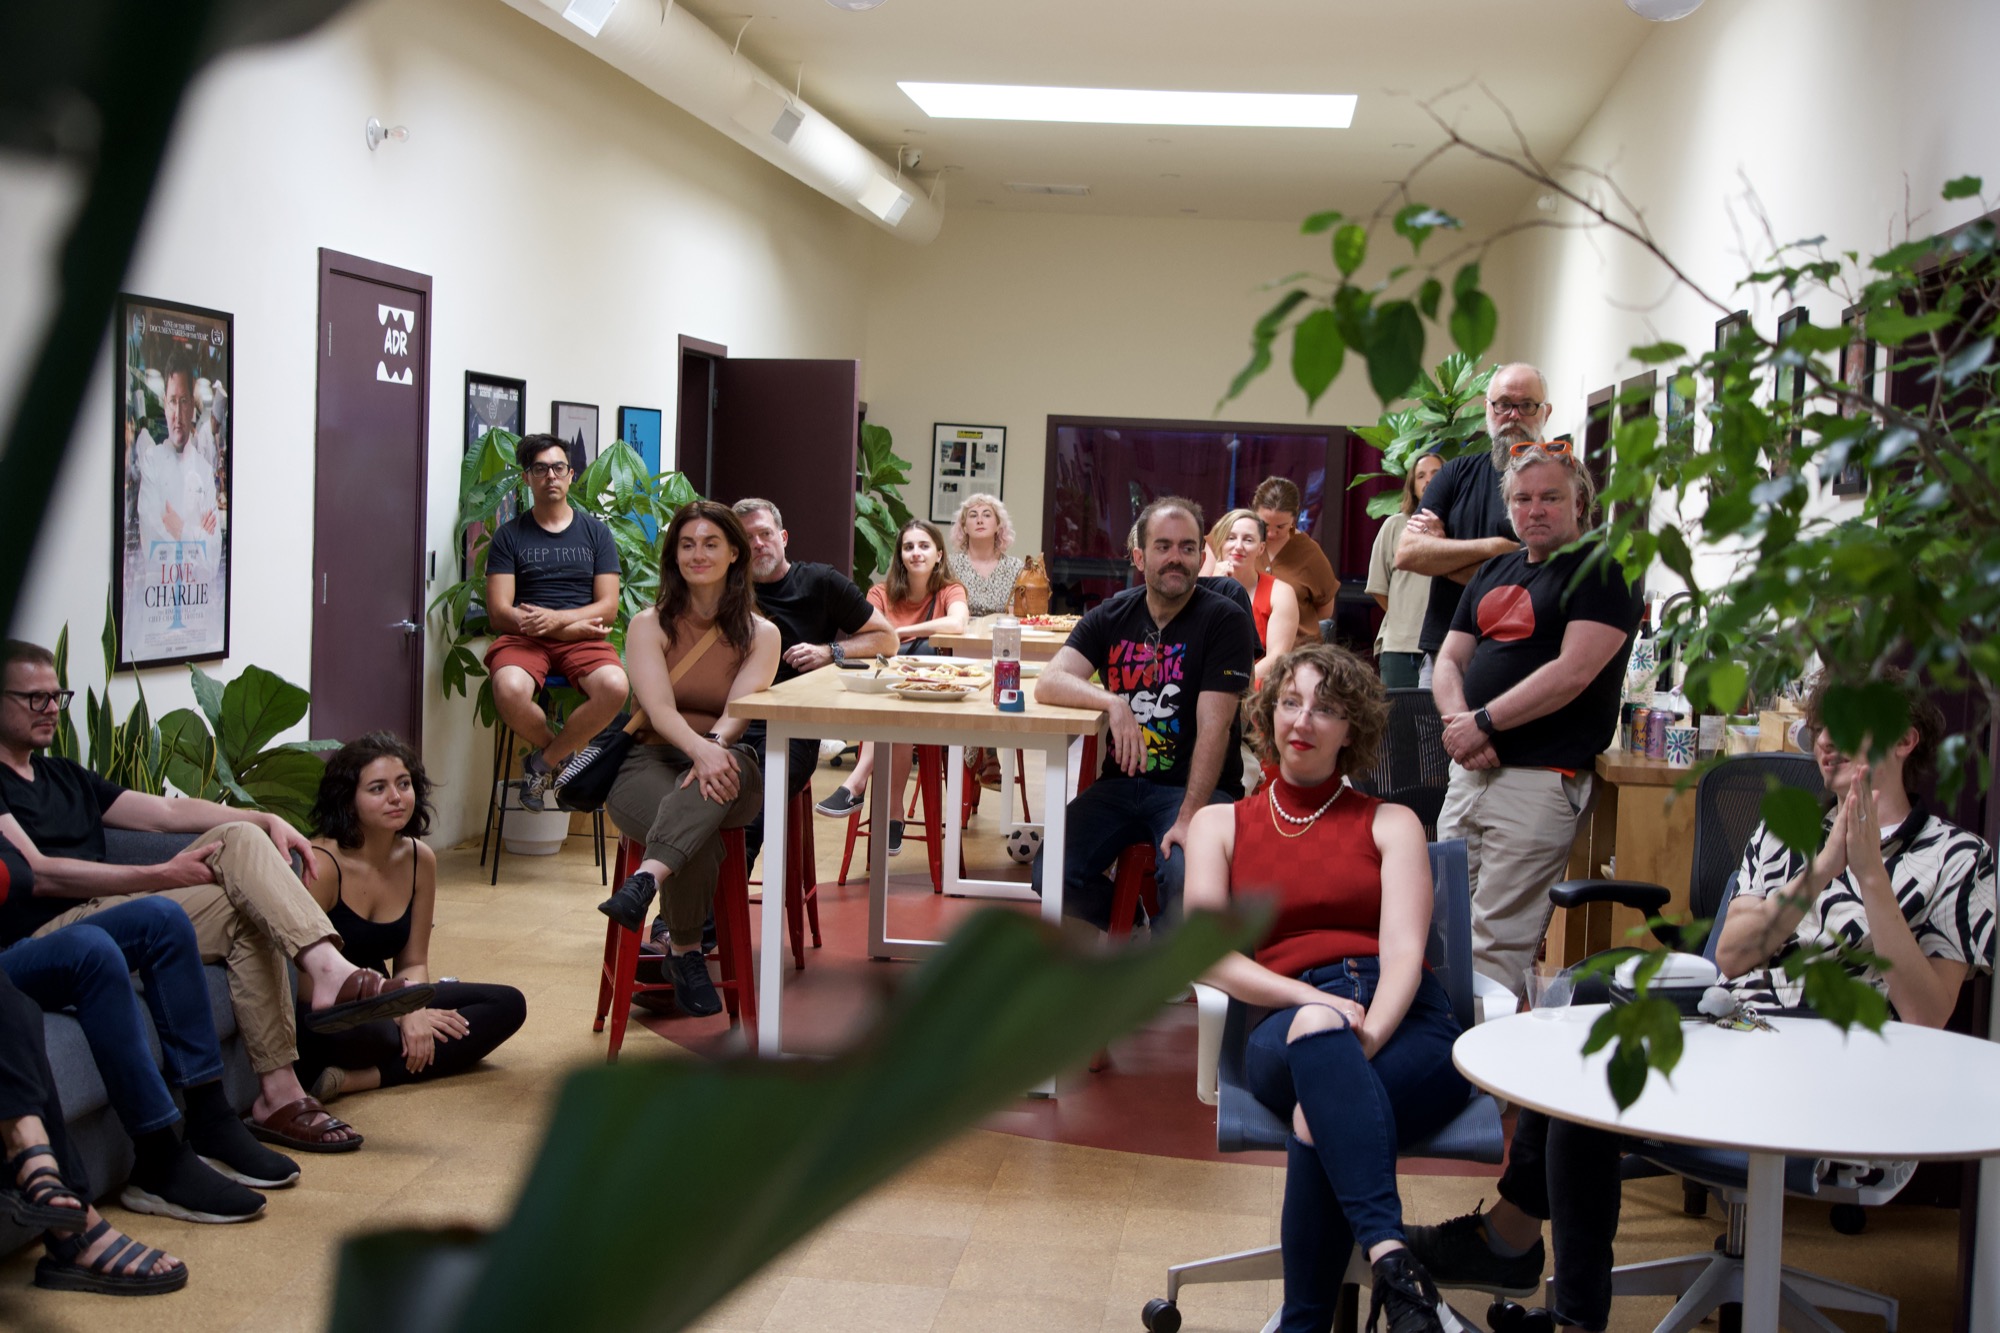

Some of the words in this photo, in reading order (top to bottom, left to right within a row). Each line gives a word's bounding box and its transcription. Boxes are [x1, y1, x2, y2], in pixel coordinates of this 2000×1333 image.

[384, 327, 408, 357] ADR
[519, 547, 550, 562] KEEP
[161, 563, 196, 584] LOVE,
[145, 584, 208, 608] CHARLIE
